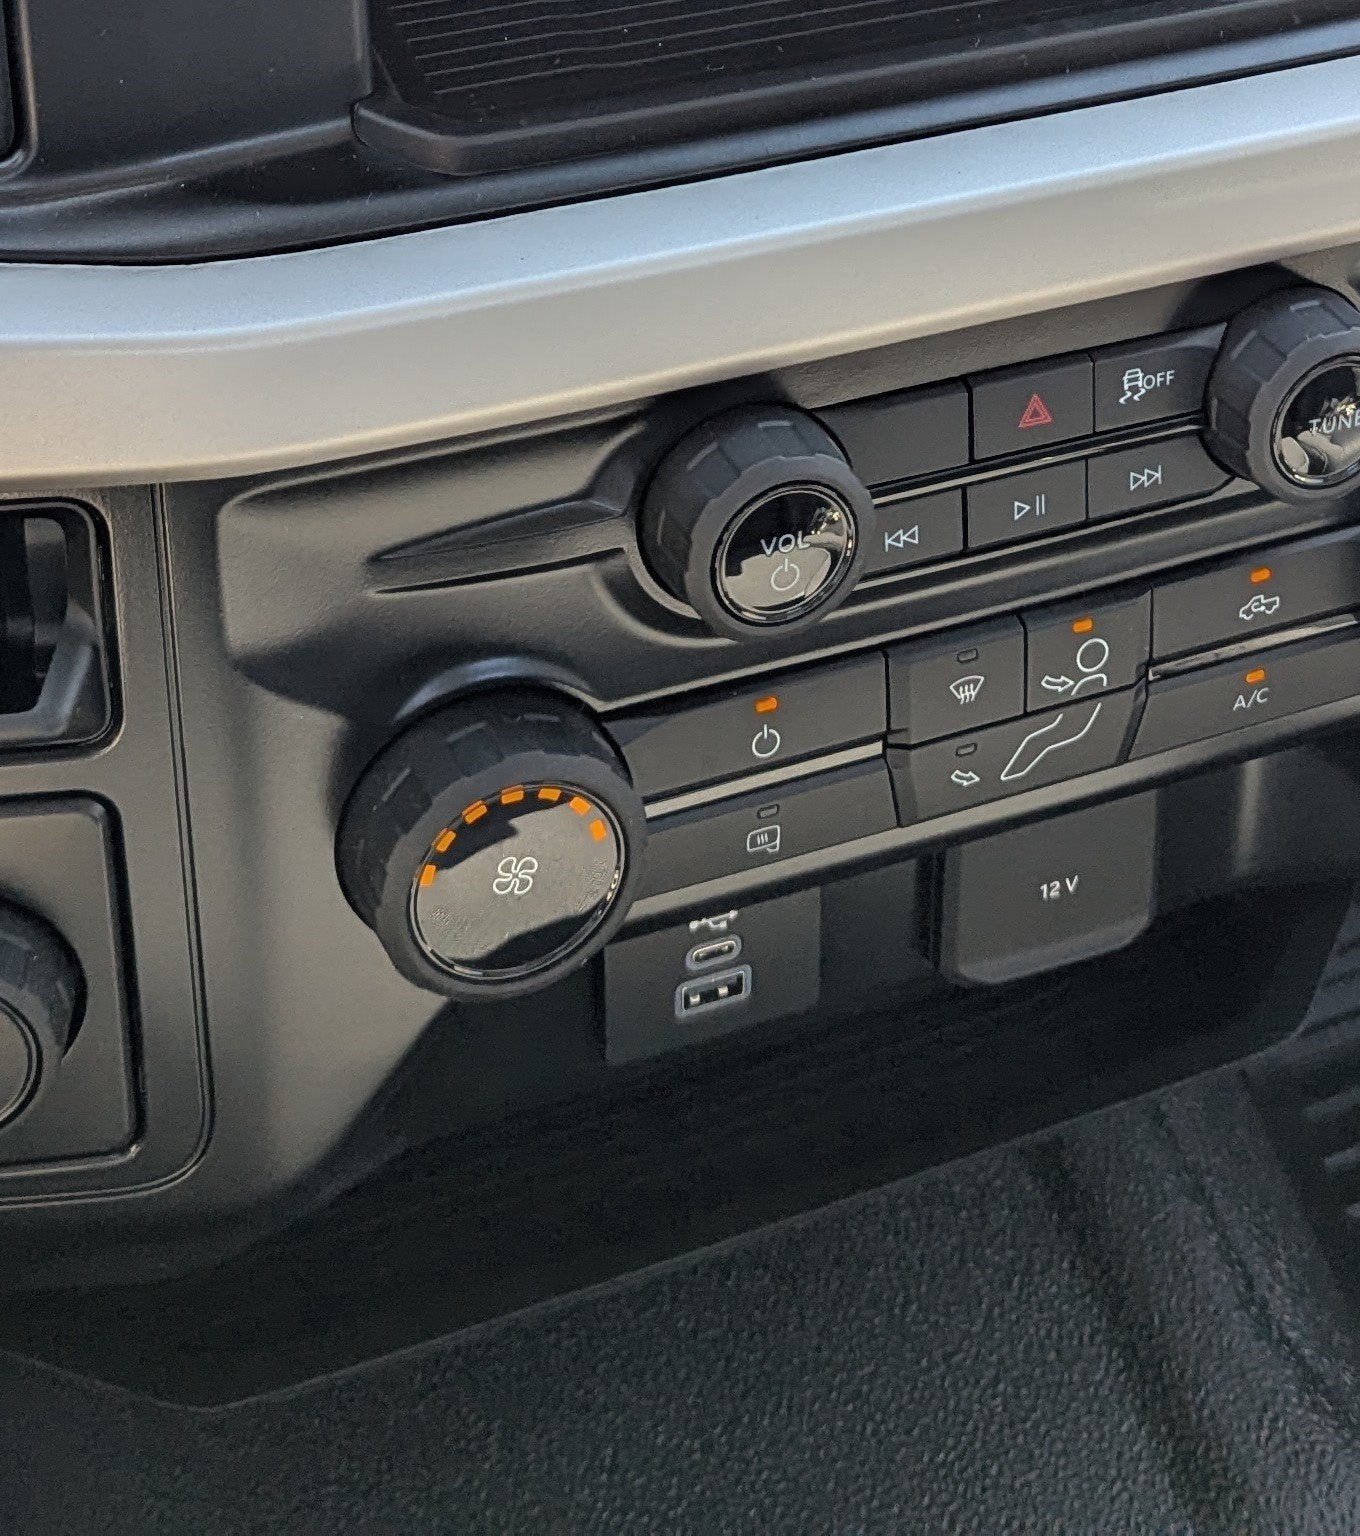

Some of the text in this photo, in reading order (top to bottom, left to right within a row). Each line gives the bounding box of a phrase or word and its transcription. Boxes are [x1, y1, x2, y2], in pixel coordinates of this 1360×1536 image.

[1143, 370, 1176, 390] OFF
[760, 531, 812, 558] VOL
[1232, 687, 1269, 710] A/C
